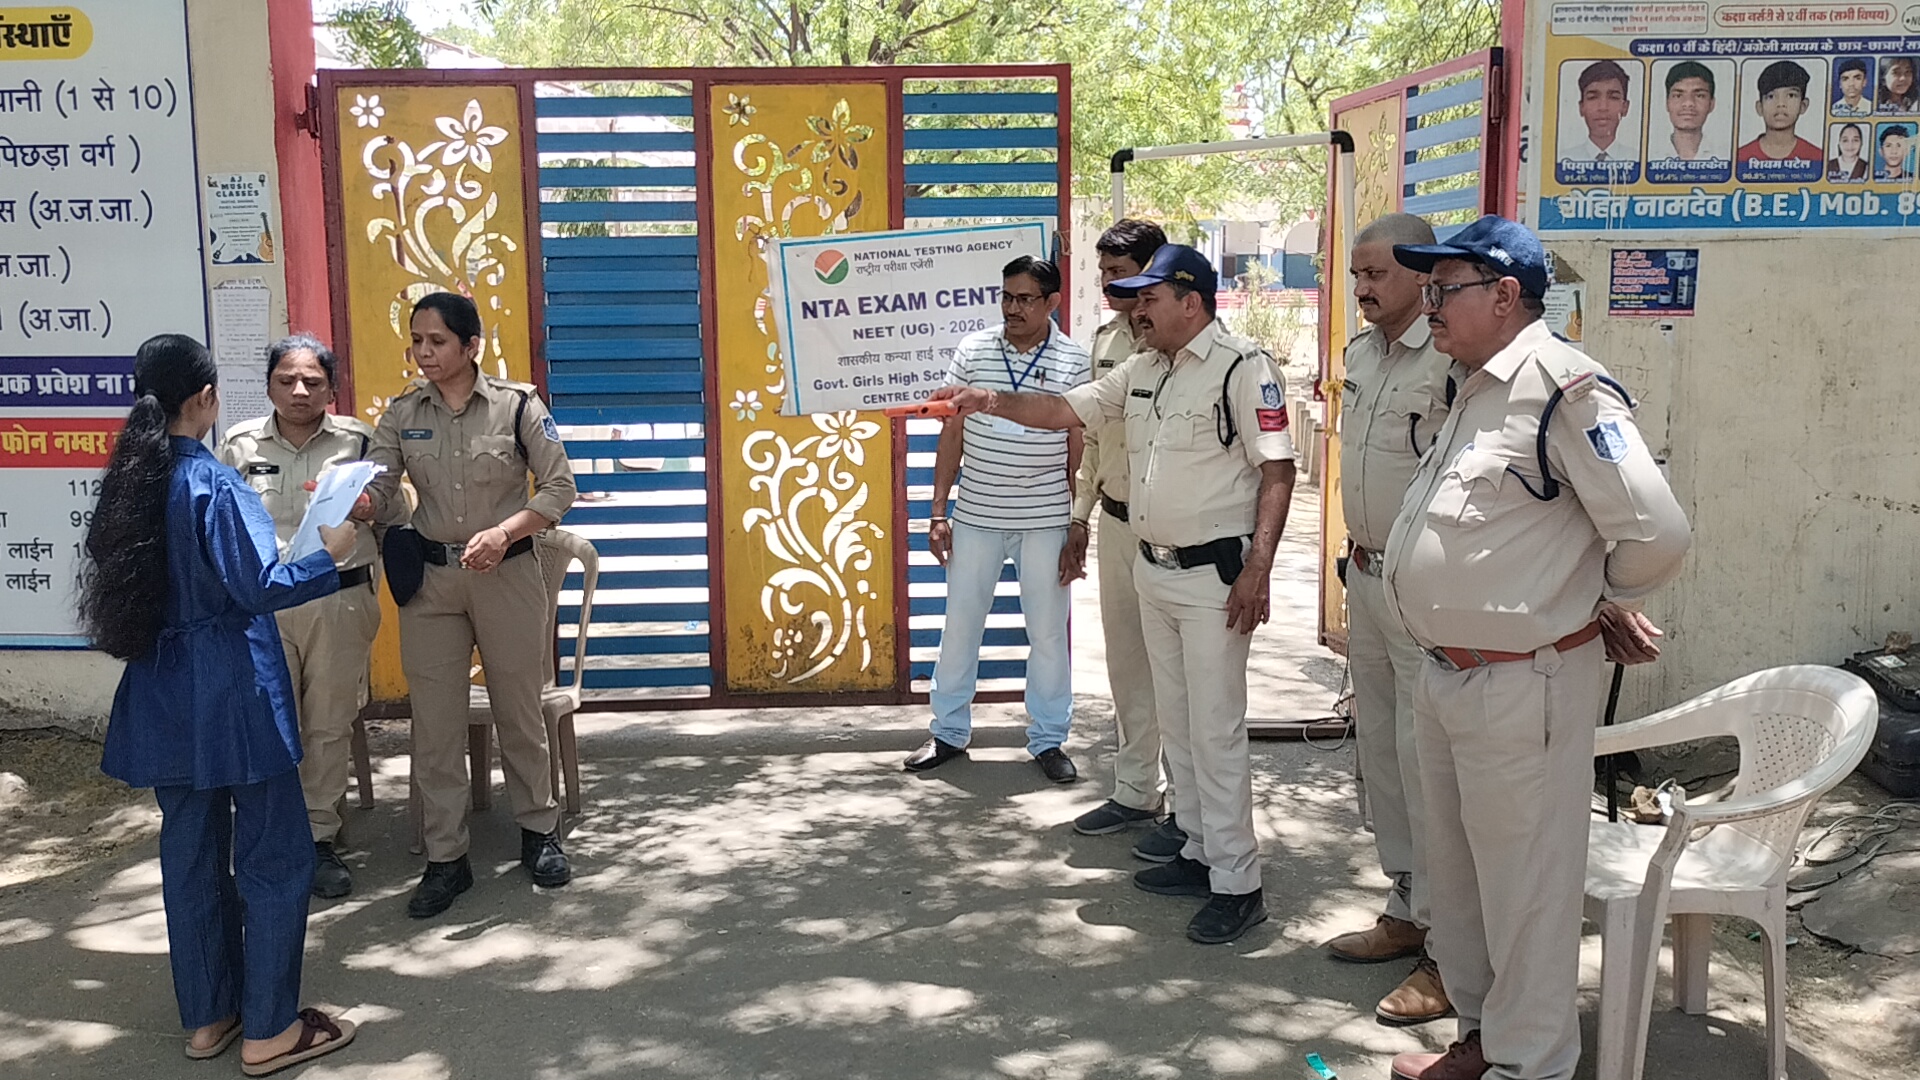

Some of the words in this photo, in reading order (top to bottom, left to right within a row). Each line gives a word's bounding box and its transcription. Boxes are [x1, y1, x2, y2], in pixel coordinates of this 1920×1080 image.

[1722, 11, 1746, 23] कक्षा
[1776, 8, 1785, 21] से
[1808, 11, 1827, 21] तक
[1829, 7, 1855, 22] (सभी
[1857, 7, 1889, 22] विषय)
[0, 14, 72, 48] स्थाएँ
[1637, 42, 1665, 54] कक्षा
[1667, 42, 1680, 53] 10
[1698, 39, 1711, 53] के
[1781, 41, 1820, 52] माध्यम
[1820, 38, 1834, 52] के
[0, 79, 42, 112] ानी
[91, 77, 115, 111] से
[129, 78, 177, 118] 10)
[79, 134, 115, 167] वर्ग
[1649, 158, 1686, 170] अरविंद
[1783, 156, 1811, 169] पटेल
[1632, 187, 1726, 218] नामदेव
[1732, 188, 1811, 222] (B.E.)
[1820, 190, 1889, 216] Mob.
[854, 249, 911, 261] NATIONAL
[914, 244, 963, 256] TESTING
[966, 240, 1013, 252] AGENCY
[801, 299, 851, 319] NTA
[858, 291, 927, 315] EXAM
[853, 326, 895, 340] NEET
[900, 322, 935, 339] (UG)
[950, 319, 985, 333] 2026
[837, 351, 880, 367] शासकीय
[885, 350, 912, 363] कन्या
[916, 346, 934, 362] हाई
[35, 368, 91, 396] प्रवेश
[95, 374, 123, 394] ना
[813, 379, 848, 391] Govt.
[852, 375, 884, 388] Girls
[889, 372, 919, 387] High
[862, 391, 910, 405] CENTRE
[0, 424, 48, 454] फोन
[53, 431, 108, 454] नम्बर
[7, 537, 54, 562] लाईन
[5, 568, 51, 593] लाईन
